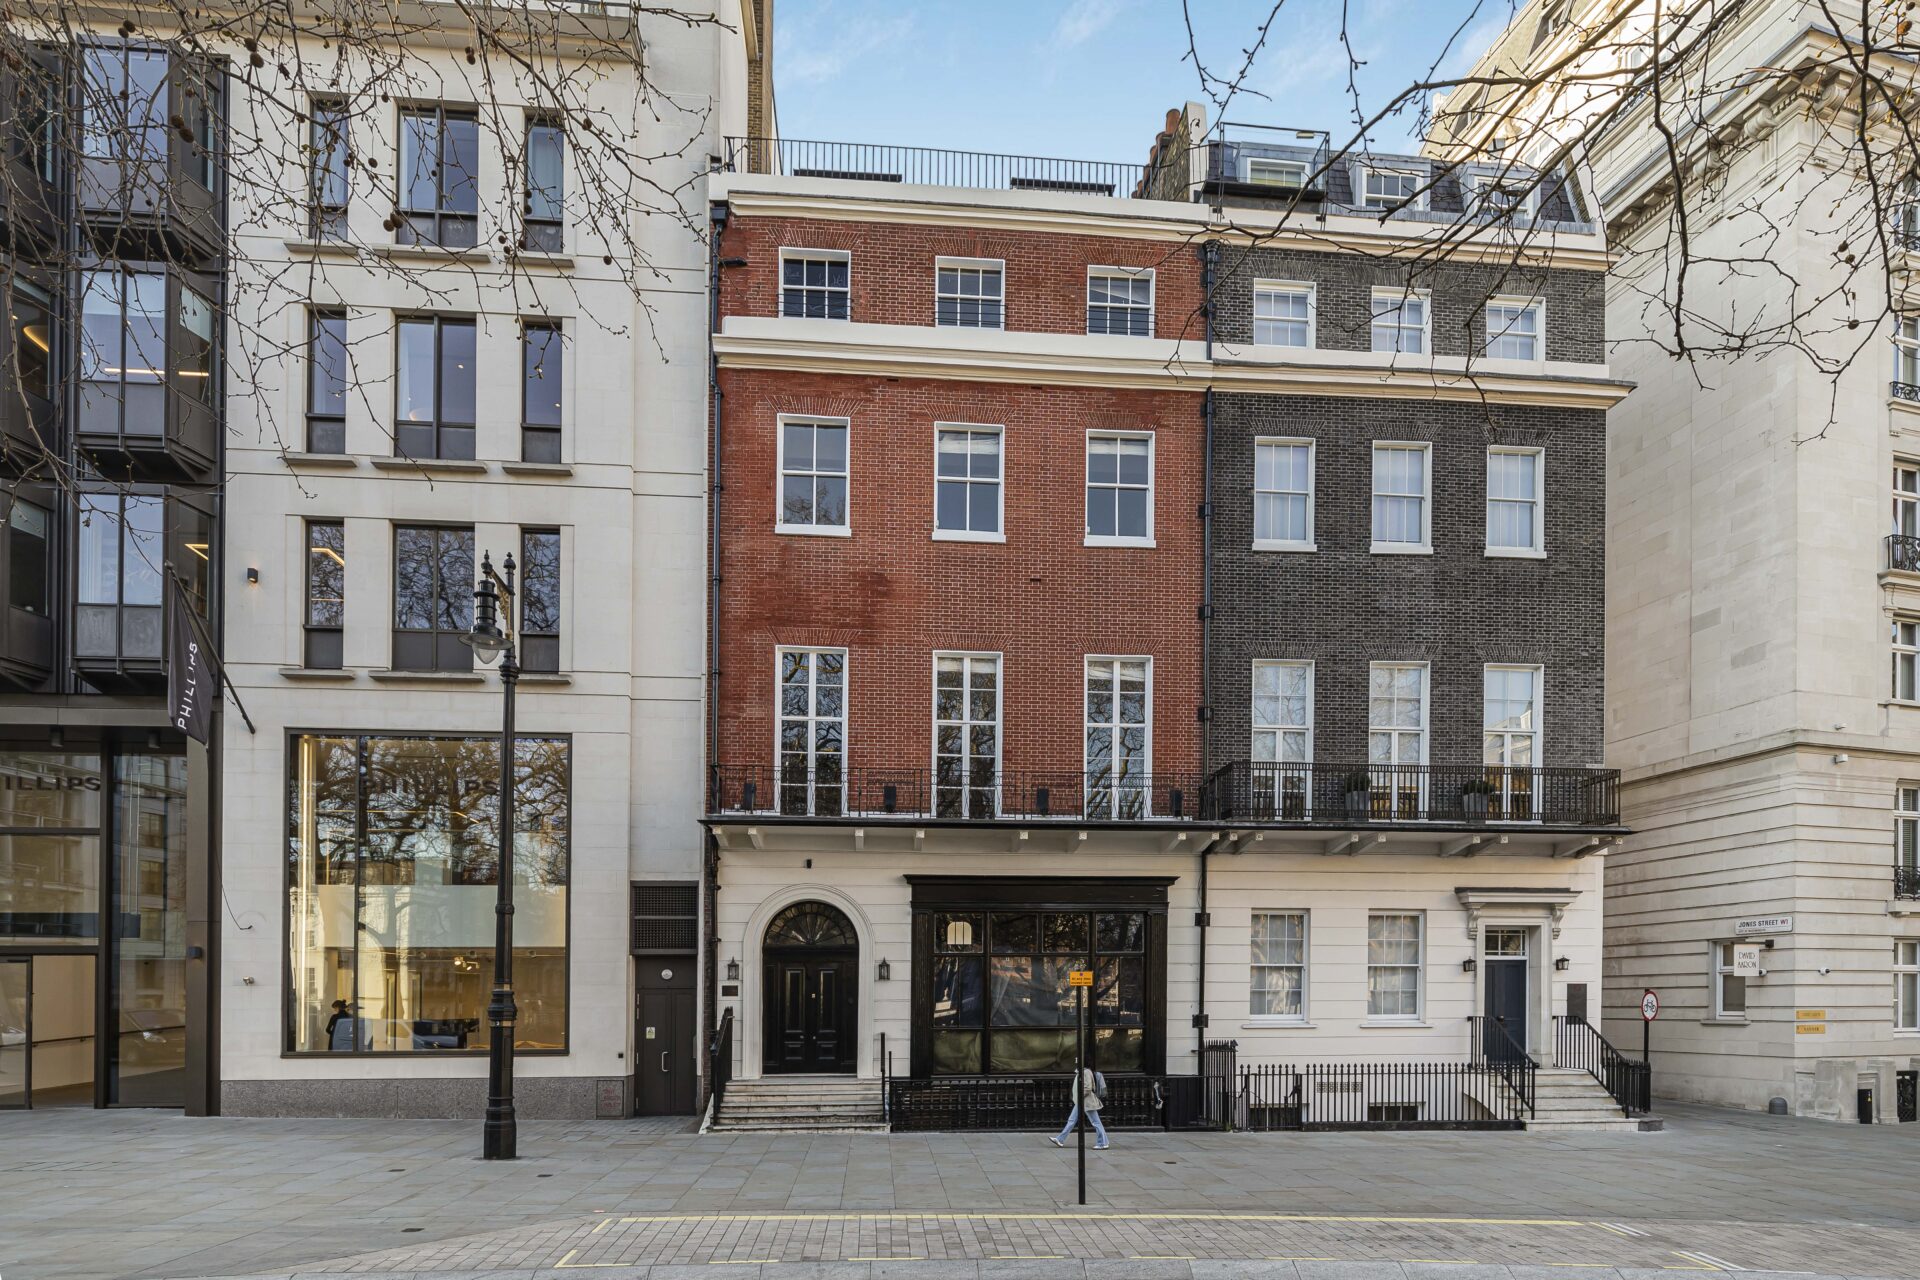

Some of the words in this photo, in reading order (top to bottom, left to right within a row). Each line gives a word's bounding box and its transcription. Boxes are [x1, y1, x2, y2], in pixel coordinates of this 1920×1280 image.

[1738, 920, 1757, 928] JONES
[1757, 919, 1778, 927] STREET
[1738, 951, 1756, 960] DAVID
[1737, 961, 1757, 969] AARON
